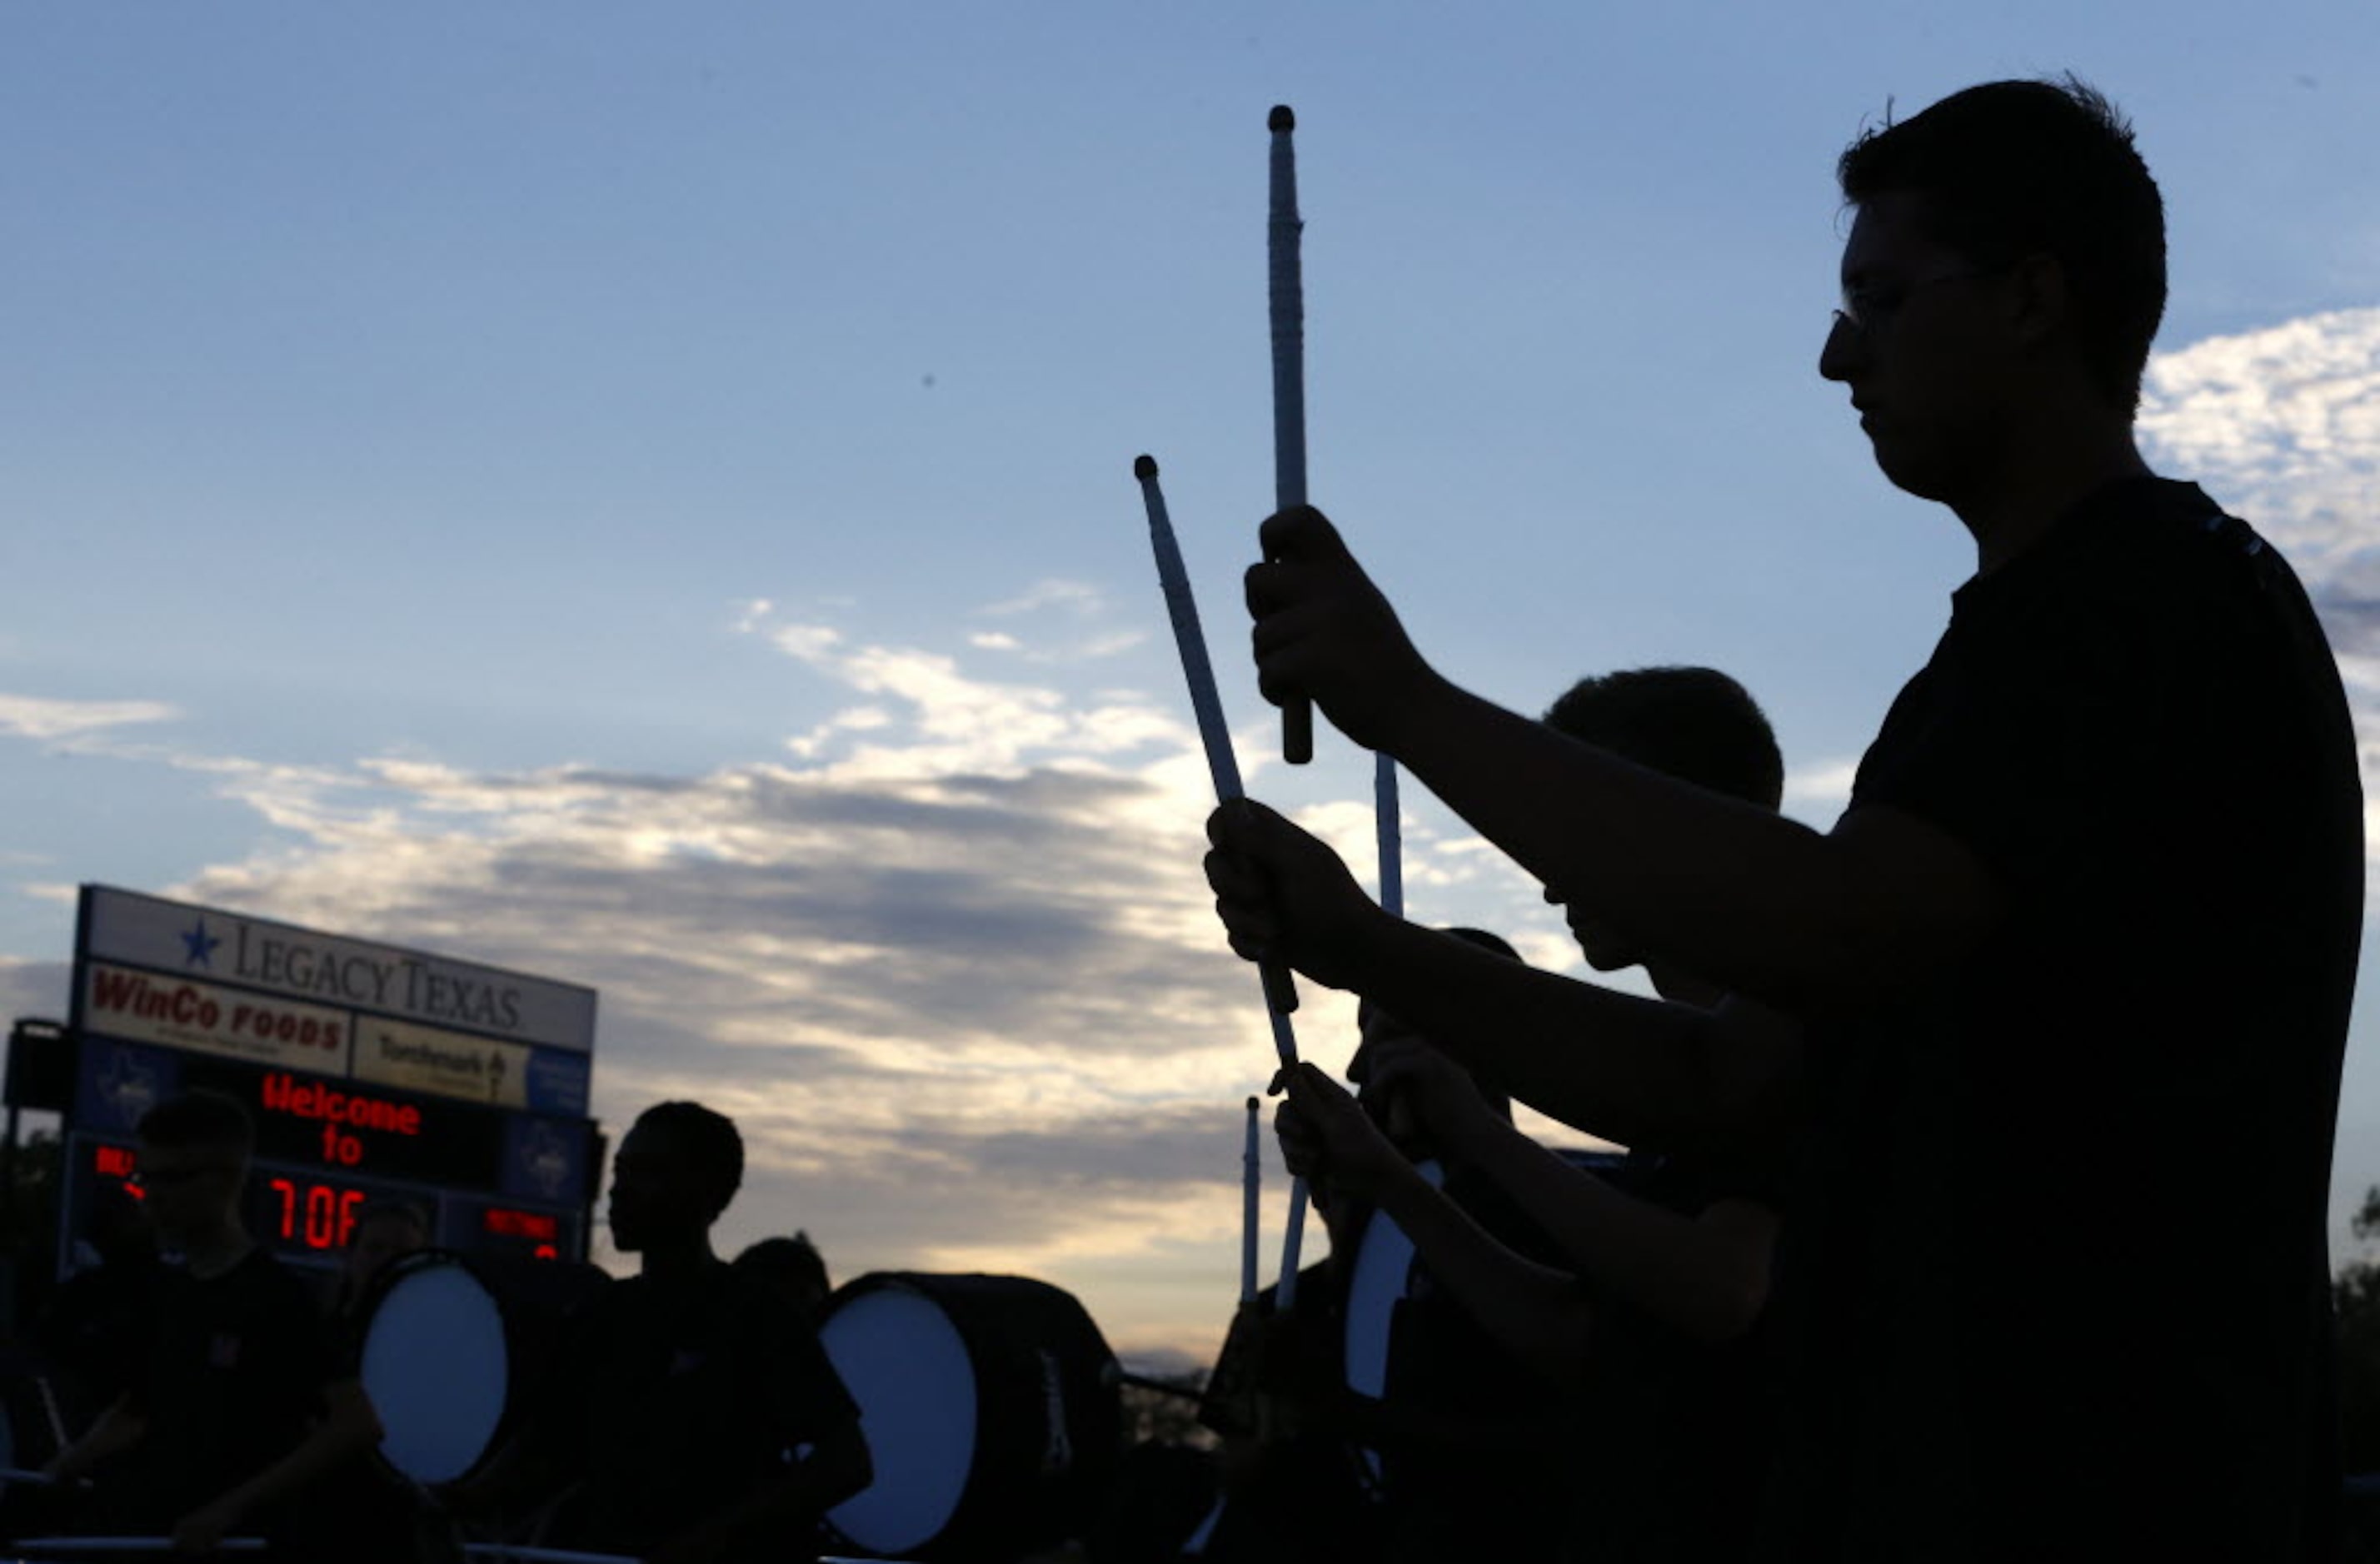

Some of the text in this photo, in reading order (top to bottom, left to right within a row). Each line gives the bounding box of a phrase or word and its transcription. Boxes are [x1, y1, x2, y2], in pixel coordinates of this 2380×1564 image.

[93, 969, 220, 1029] WinCo
[230, 1004, 342, 1050] FOODS
[262, 1073, 422, 1135] Welcome
[323, 1123, 362, 1165] to
